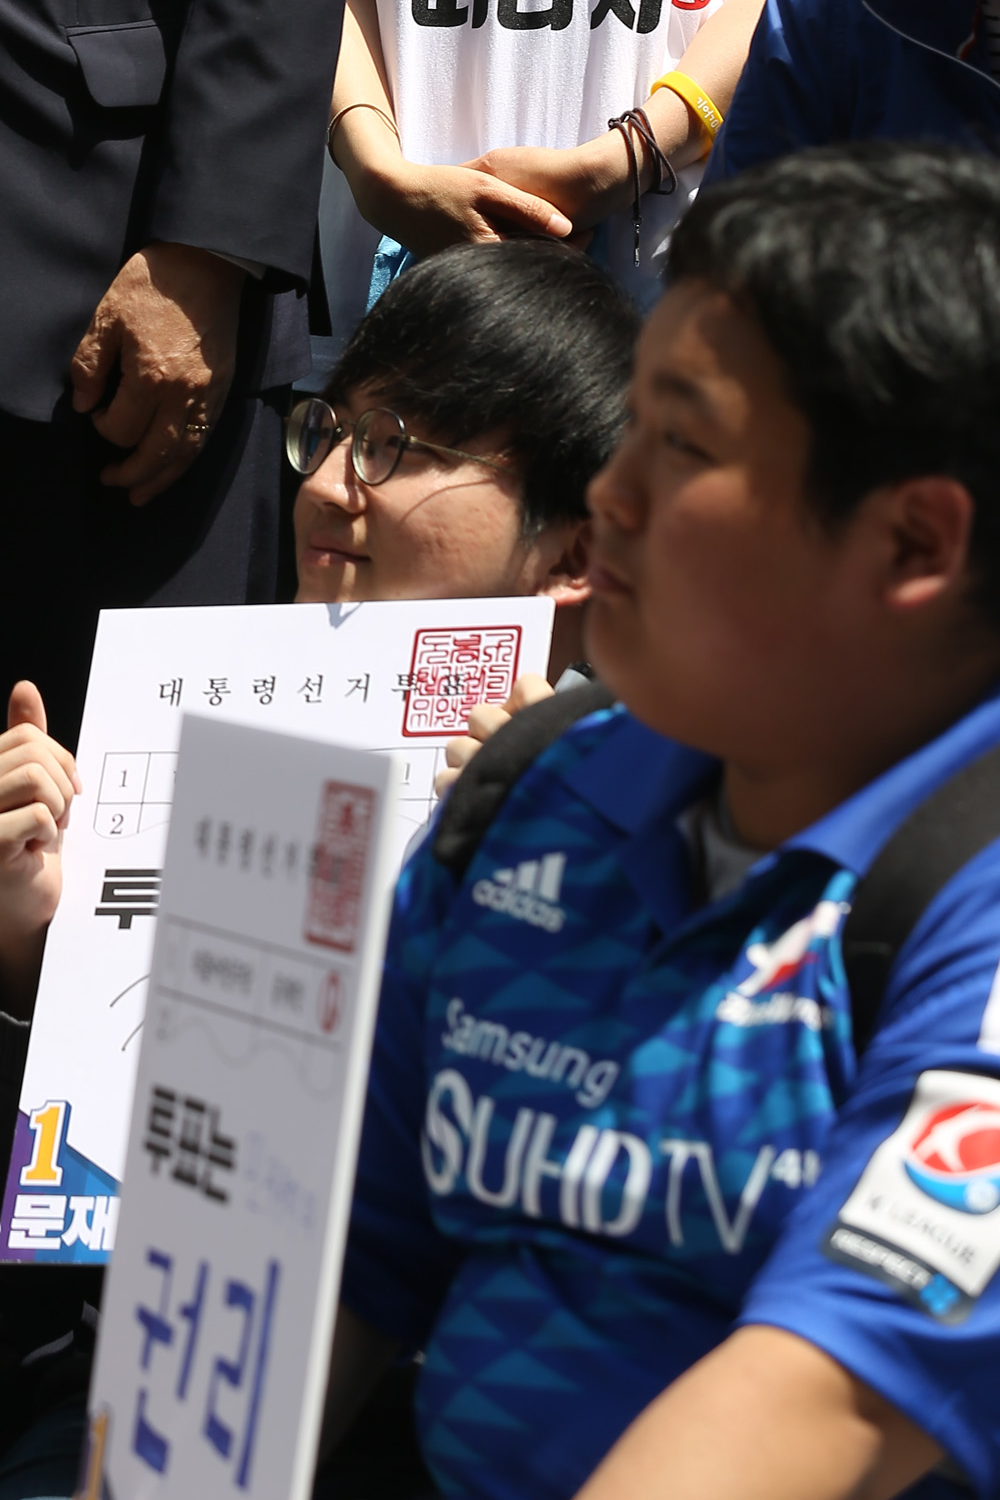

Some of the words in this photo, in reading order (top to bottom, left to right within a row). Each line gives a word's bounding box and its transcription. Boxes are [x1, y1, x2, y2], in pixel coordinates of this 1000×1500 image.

[118, 769, 128, 788] 1
[110, 813, 125, 835] 2
[472, 879, 567, 934] adidas
[18, 1100, 69, 1187] 1
[6, 1194, 116, 1252] 문재
